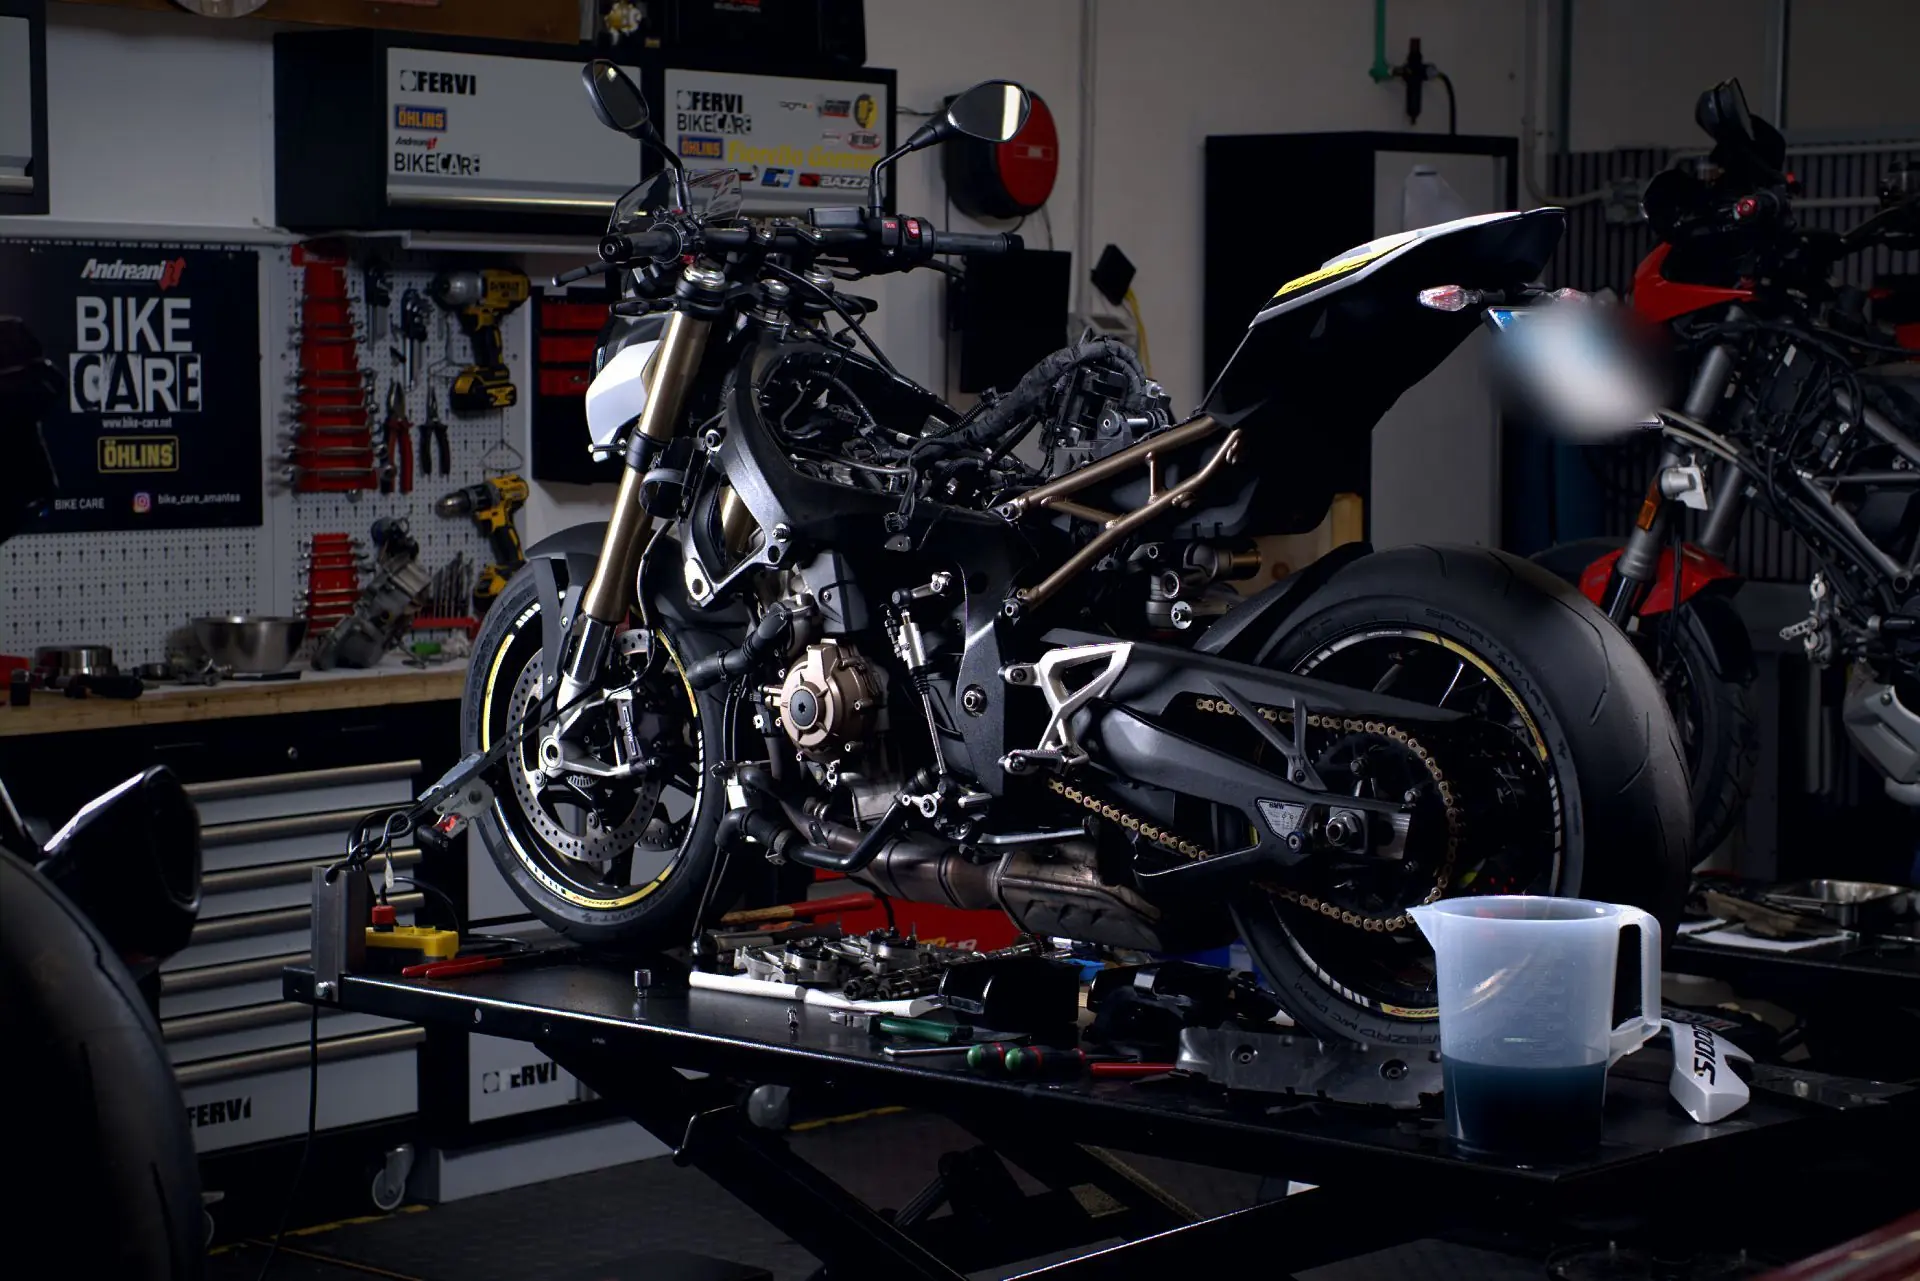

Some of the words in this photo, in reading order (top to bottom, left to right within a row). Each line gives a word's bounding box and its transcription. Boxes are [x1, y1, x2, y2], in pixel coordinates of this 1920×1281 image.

[416, 71, 476, 96] FERVI
[691, 91, 743, 114] FERVI
[398, 107, 444, 128] ÖHLINS
[819, 175, 871, 190] BAZZA
[81, 258, 165, 280] Andreani
[76, 296, 192, 352] BIKE
[69, 353, 202, 412] CARE
[104, 440, 174, 468] ÖHLINS
[54, 499, 77, 510] BIKE
[79, 498, 104, 509] CARE
